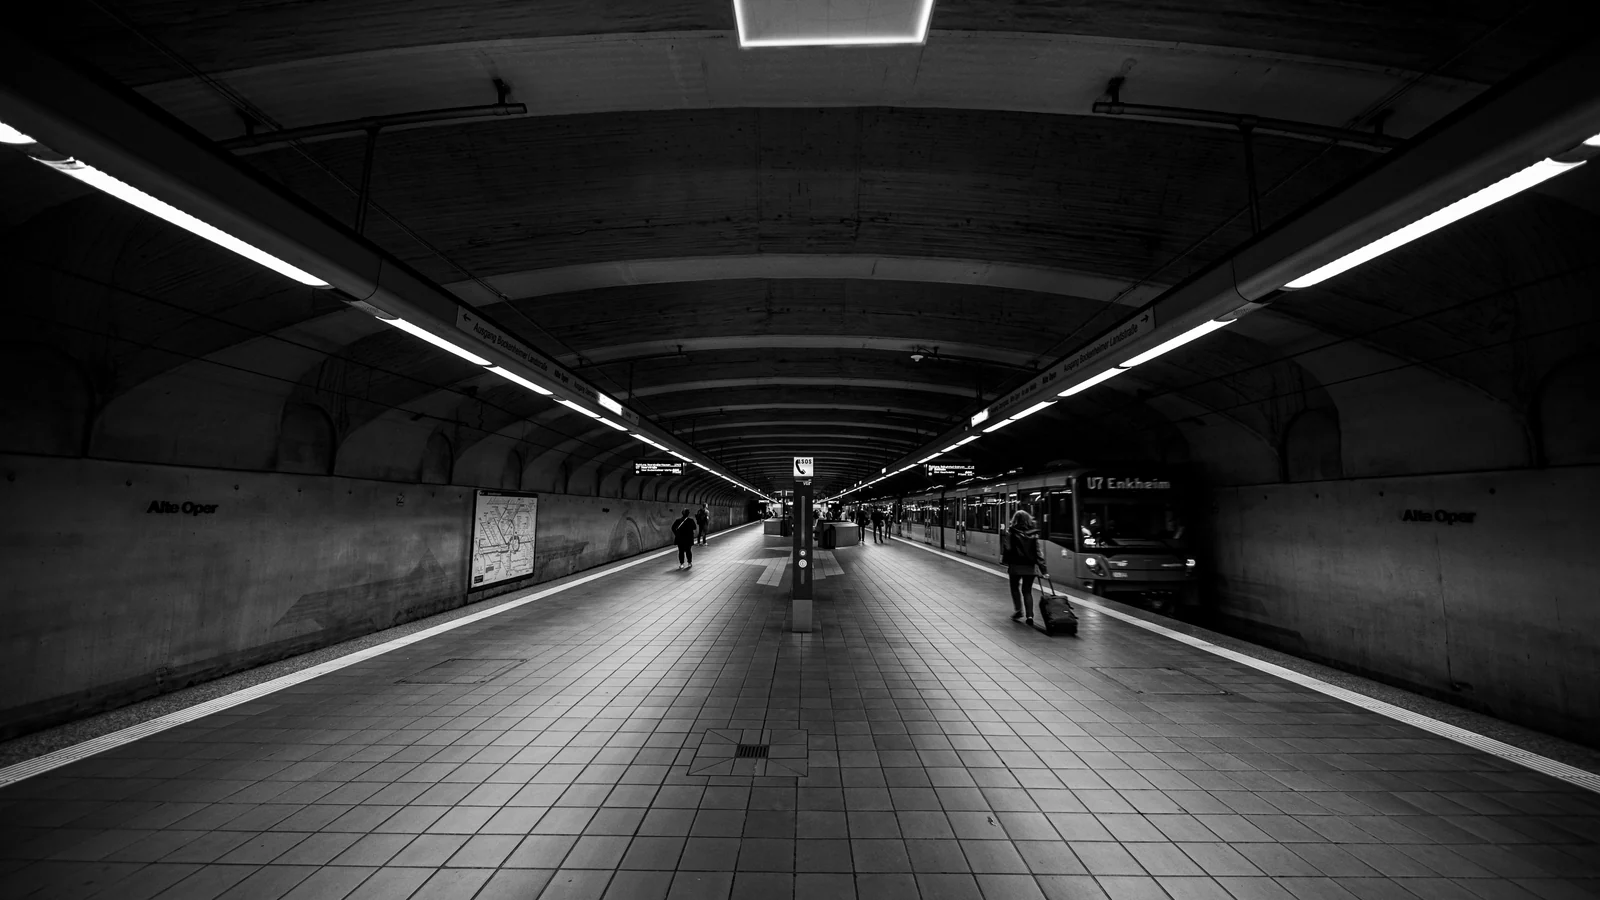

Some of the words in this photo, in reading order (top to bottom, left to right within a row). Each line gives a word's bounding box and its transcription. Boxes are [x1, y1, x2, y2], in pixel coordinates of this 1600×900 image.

[473, 322, 497, 343] Ausgang
[497, 335, 528, 360] Bockenheimer
[1063, 358, 1080, 373] Ausgang
[1079, 341, 1109, 364] Bockenheimer
[1109, 324, 1138, 347] Landstraße
[1087, 476, 1103, 490] U7
[1107, 477, 1171, 490] Enkheim
[146, 500, 180, 514] Alte
[181, 501, 219, 516] Oper
[1402, 509, 1433, 521] Alte
[1434, 509, 1477, 525] Oper
